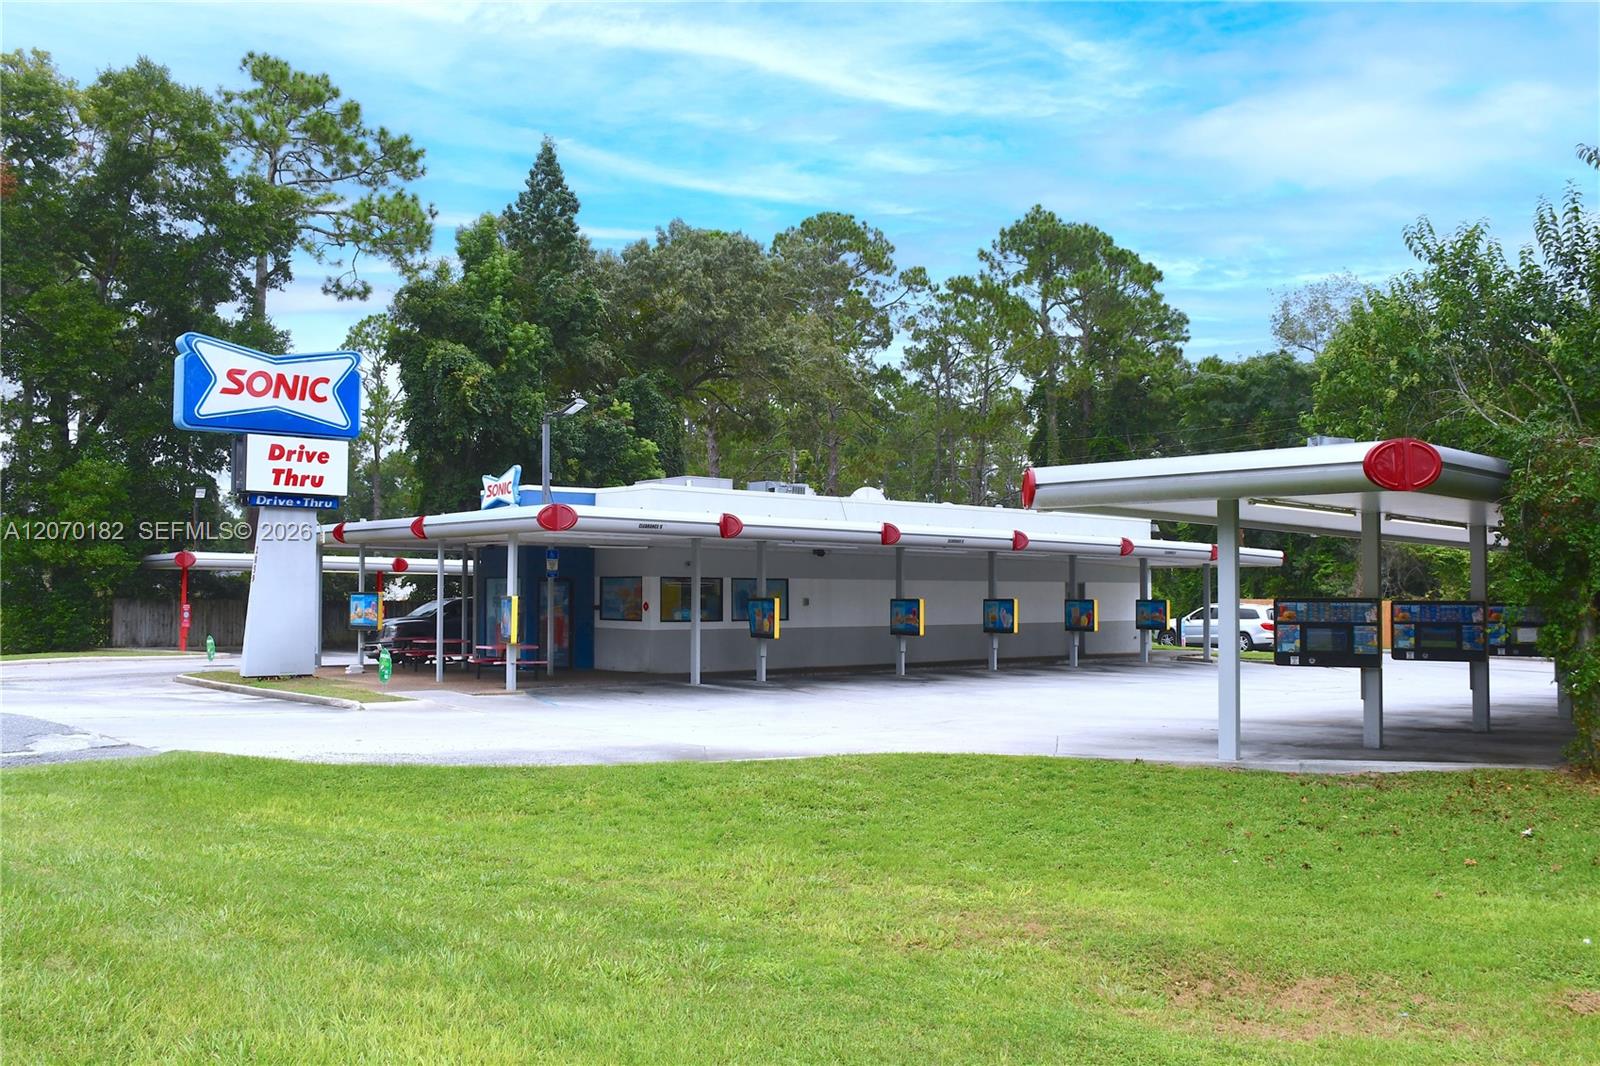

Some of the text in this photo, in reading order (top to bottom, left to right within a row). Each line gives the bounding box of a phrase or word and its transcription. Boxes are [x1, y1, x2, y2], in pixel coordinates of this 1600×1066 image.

[219, 368, 331, 403] SONIC
[268, 443, 330, 464] Drive
[272, 468, 325, 488] Thru
[486, 481, 512, 498] SONIC
[256, 495, 333, 508] Drive Thru
